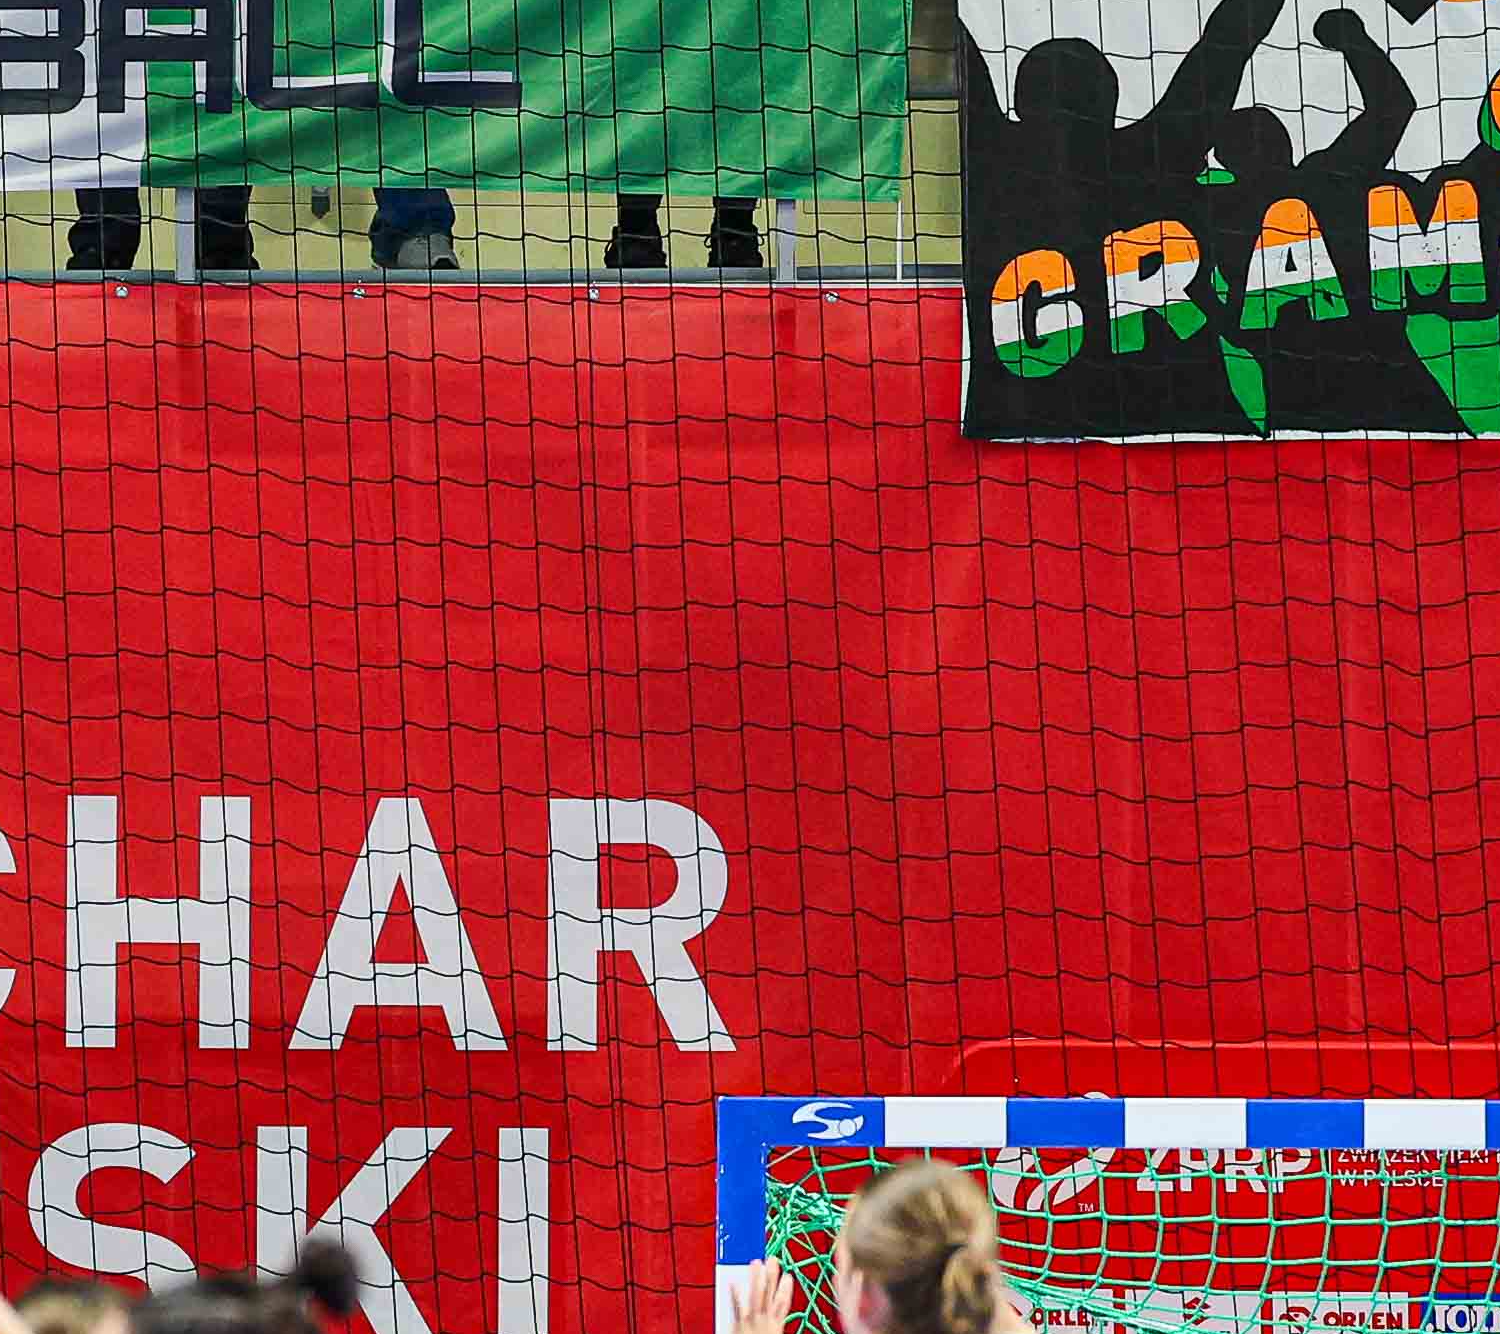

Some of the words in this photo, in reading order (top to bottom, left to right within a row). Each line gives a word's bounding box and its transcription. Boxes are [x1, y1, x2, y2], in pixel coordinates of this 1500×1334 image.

[1136, 1149, 1313, 1193] ZPRP
[1031, 1308, 1108, 1327] ORLE
[1323, 1311, 1402, 1329] ORLEN
